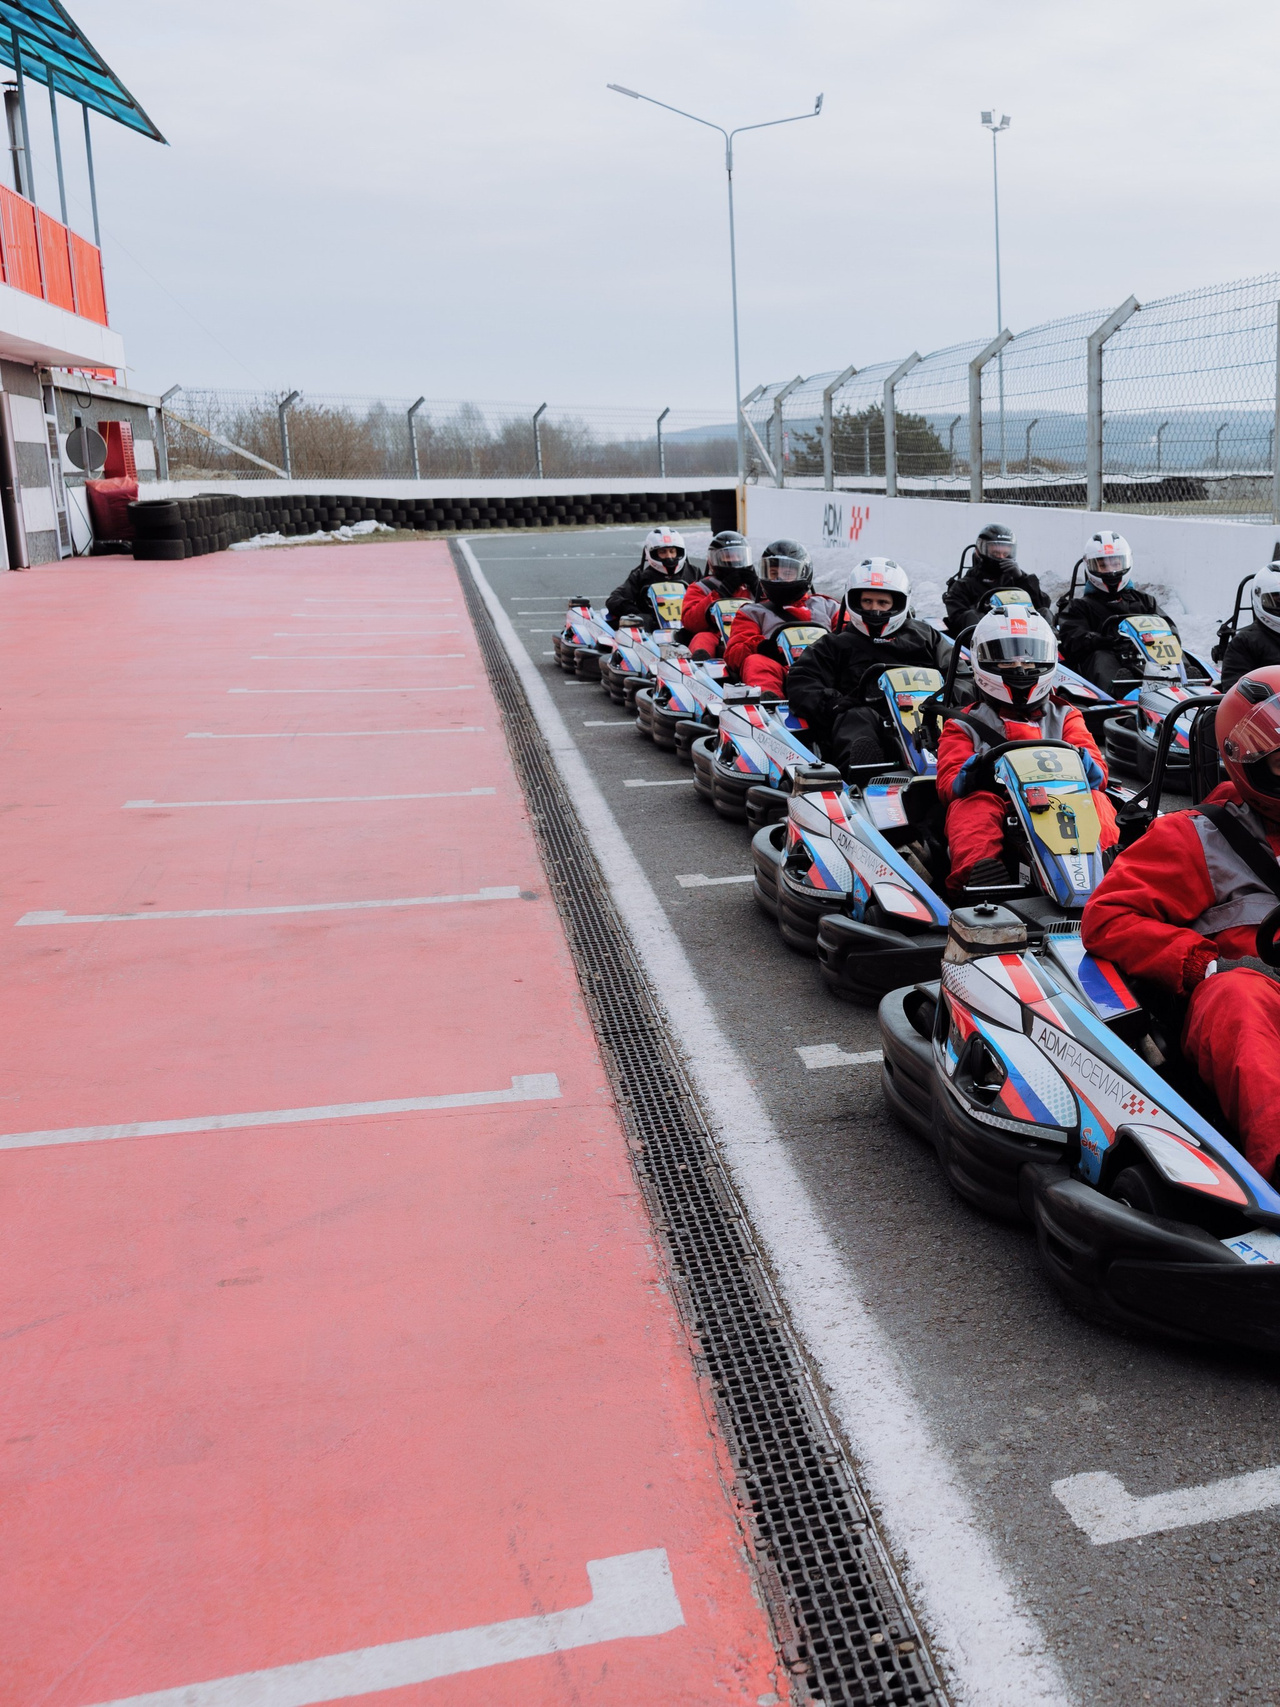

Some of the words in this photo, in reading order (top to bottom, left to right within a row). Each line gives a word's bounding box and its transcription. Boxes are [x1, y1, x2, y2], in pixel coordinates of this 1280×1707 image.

[823, 503, 842, 537] ADM
[665, 606, 681, 616] 11
[1138, 617, 1165, 628] 20
[793, 628, 820, 641] 12
[1152, 645, 1176, 659] 20
[897, 669, 933, 687] 14
[1032, 749, 1063, 773] 8
[1056, 812, 1079, 840] 8
[836, 832, 881, 874] ADMRACEWAY
[1037, 1027, 1132, 1106] ADMRACEWAY
[1230, 1240, 1275, 1264] RT
